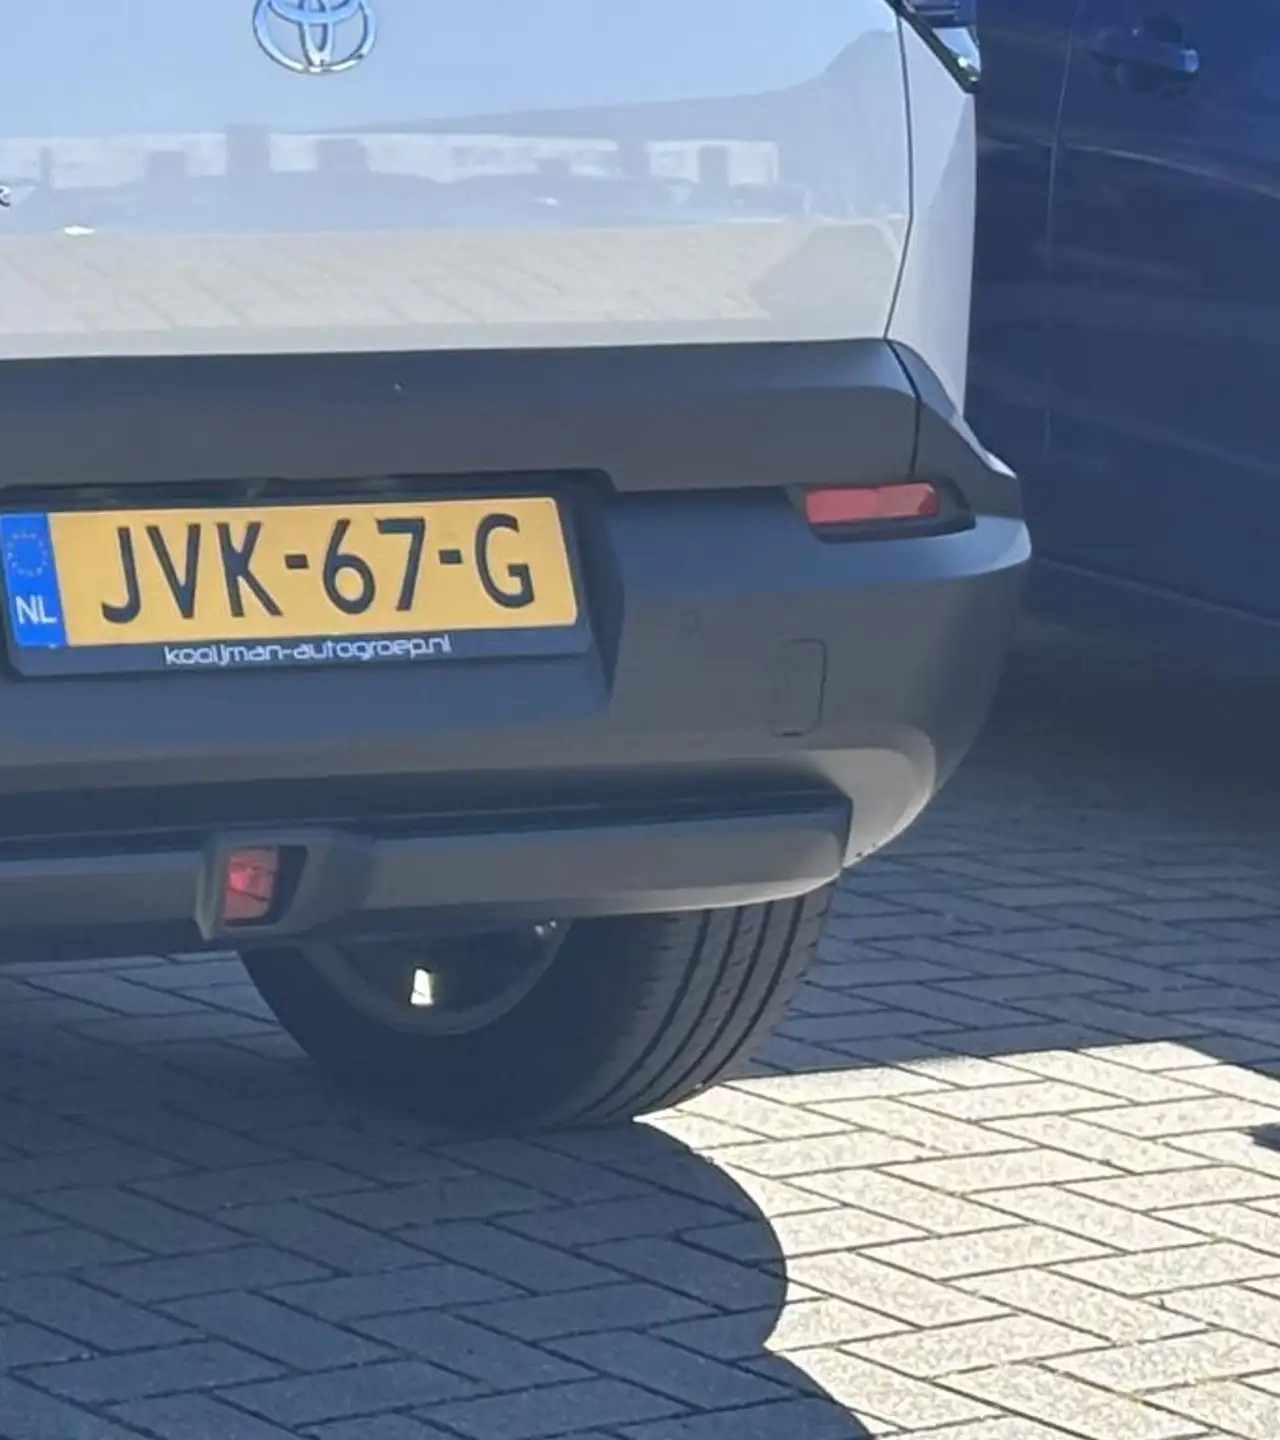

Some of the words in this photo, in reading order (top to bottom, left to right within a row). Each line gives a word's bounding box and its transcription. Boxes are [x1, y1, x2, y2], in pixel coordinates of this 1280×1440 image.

[101, 512, 535, 624] JVK-67-G
[15, 594, 57, 625] NL
[163, 633, 453, 667] kooijman-autogroep.nl
